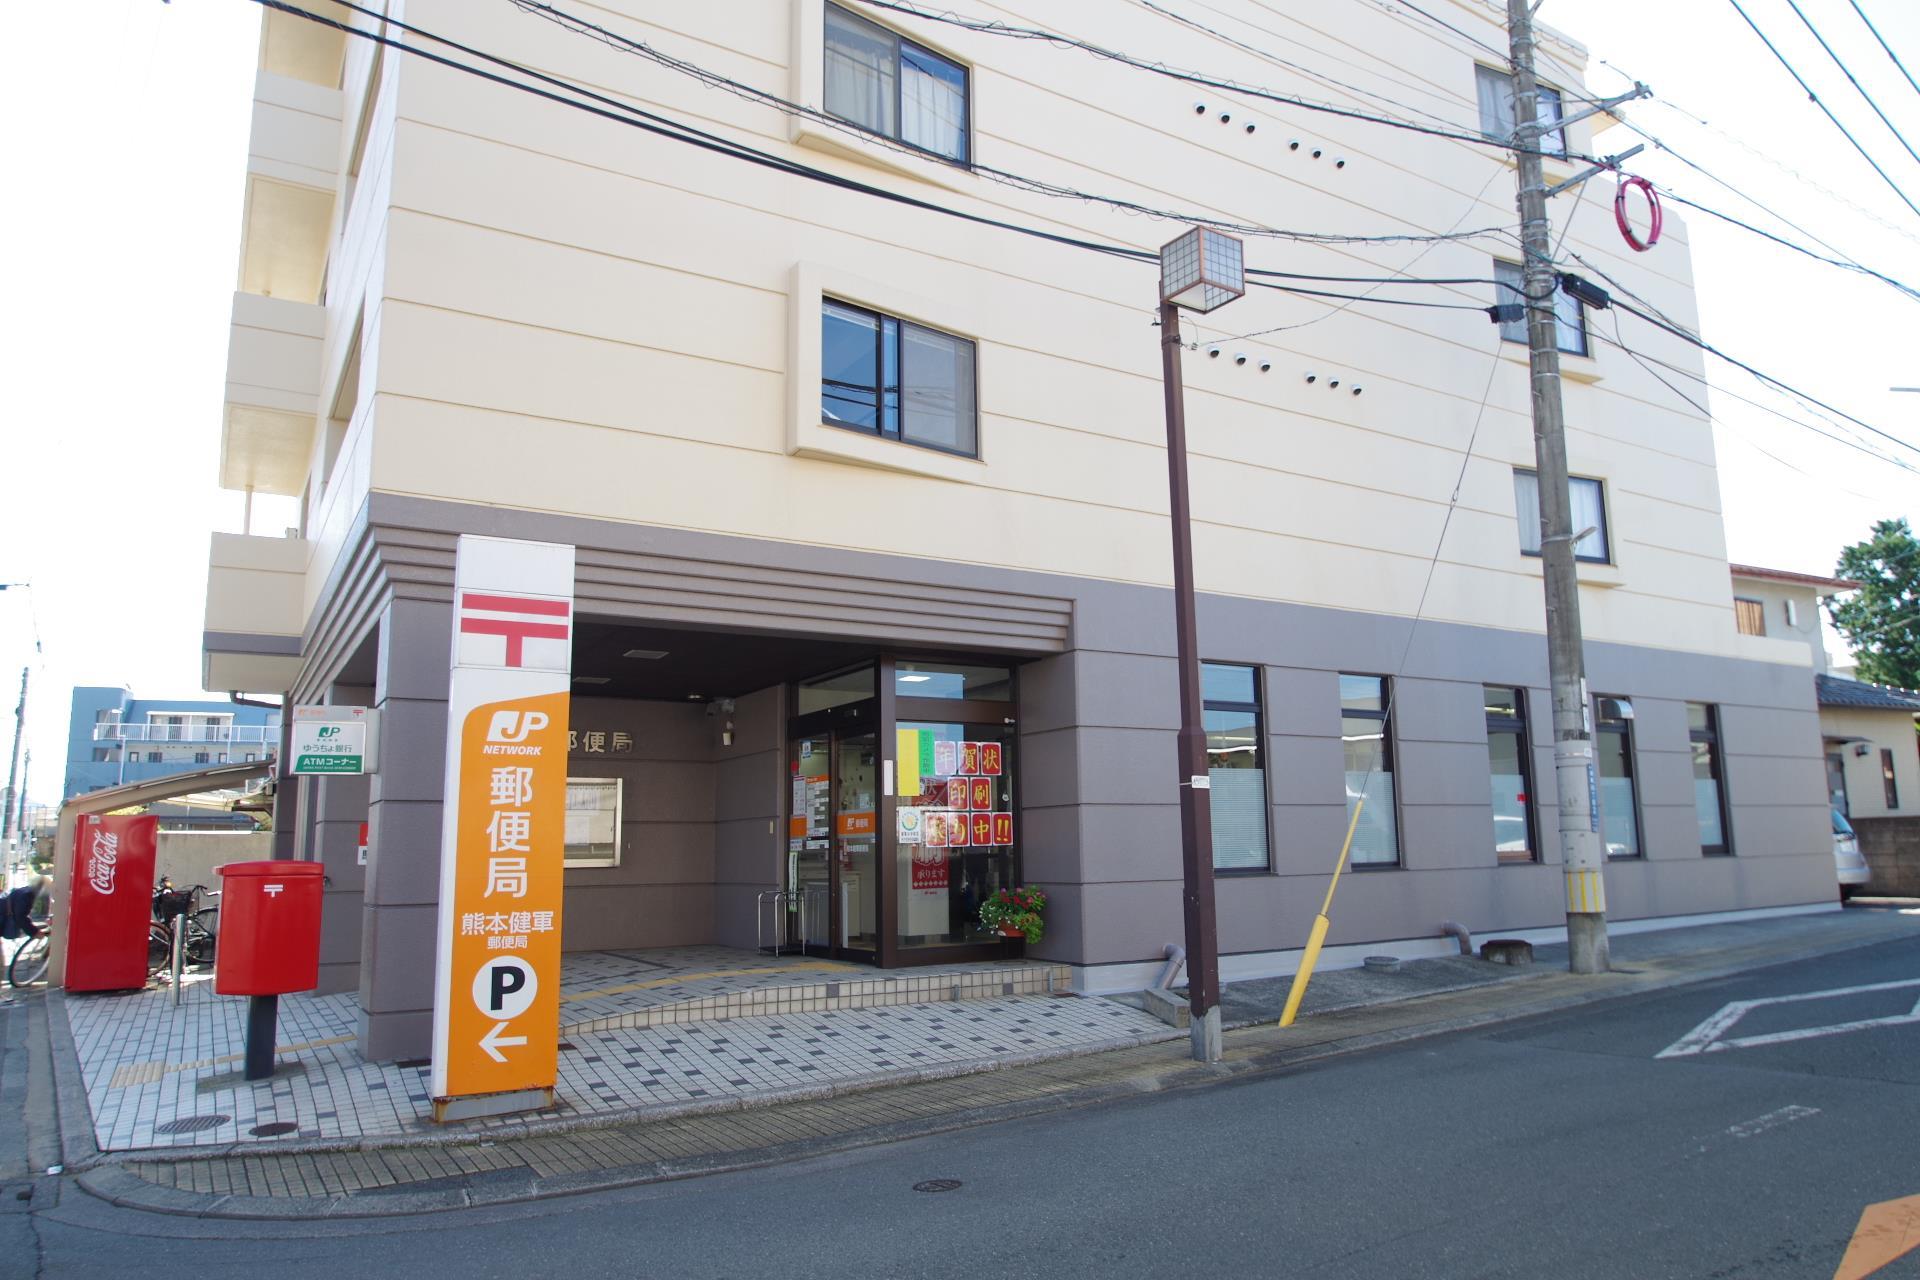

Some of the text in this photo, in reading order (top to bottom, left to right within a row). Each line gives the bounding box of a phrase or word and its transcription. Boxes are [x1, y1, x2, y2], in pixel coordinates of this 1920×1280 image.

[319, 726, 341, 738] JP
[486, 710, 549, 743] JP
[303, 744, 353, 753] ゆうちょ銀行
[483, 744, 542, 756] NETWORK
[938, 747, 999, 771] 年賀状
[303, 757, 357, 766] ATMコーナー
[950, 782, 989, 806] 印刷
[483, 766, 534, 899] 郵便局
[91, 829, 118, 895] Coca-Cola
[461, 911, 554, 936] 熊本健軍
[487, 935, 528, 949] 郵便局
[490, 966, 526, 1011] P
